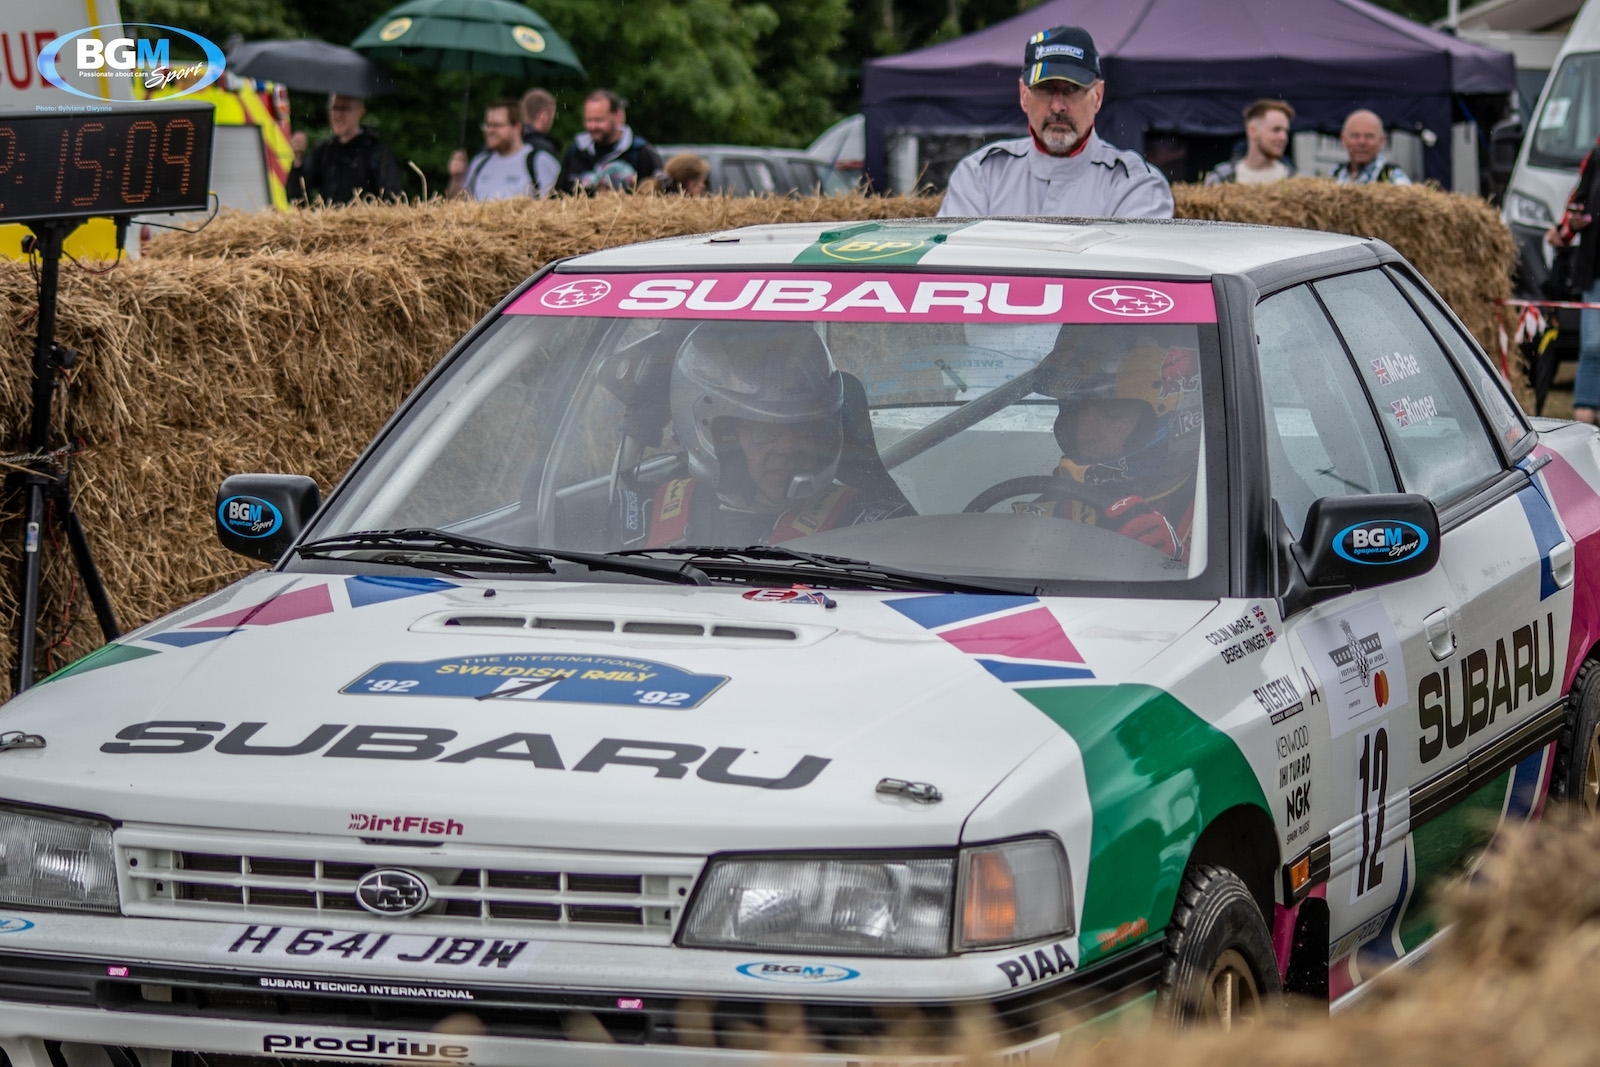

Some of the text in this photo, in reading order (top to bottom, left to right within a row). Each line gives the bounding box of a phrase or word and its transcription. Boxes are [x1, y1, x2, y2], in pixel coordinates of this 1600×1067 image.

[0, 32, 66, 91] UE
[835, 241, 913, 252] BP
[618, 278, 1064, 316] SUBARU
[1381, 352, 1421, 382] McRae
[1401, 394, 1438, 426] Ringer
[229, 501, 262, 521] BGM
[251, 519, 273, 532] Sport
[1352, 527, 1402, 548] BGM
[1388, 539, 1418, 556] Sport
[1205, 615, 1255, 646] COLIN McRAE
[461, 655, 653, 671] THE INTERNATIONAL
[1220, 632, 1269, 665] DEREK RINGER
[364, 678, 420, 693] '92
[435, 664, 658, 683] SWEDISH RALLY
[1418, 612, 1555, 764] SUBARU
[633, 690, 691, 706] '92
[1253, 675, 1301, 714] BILSTEIN
[100, 720, 832, 791] SUBARU
[1275, 725, 1309, 760] KENWOOD
[1289, 752, 1311, 783] TURBO
[1286, 779, 1311, 828] NGK
[1357, 727, 1389, 898] 12
[348, 813, 464, 836] DirtFish
[228, 924, 529, 969] H 641 JBW
[762, 964, 825, 975] BGM
[997, 943, 1075, 988] PIAA
[260, 978, 474, 999] SUBARU TECNICA INTERNATIONAL
[263, 1034, 470, 1058] prodrive
